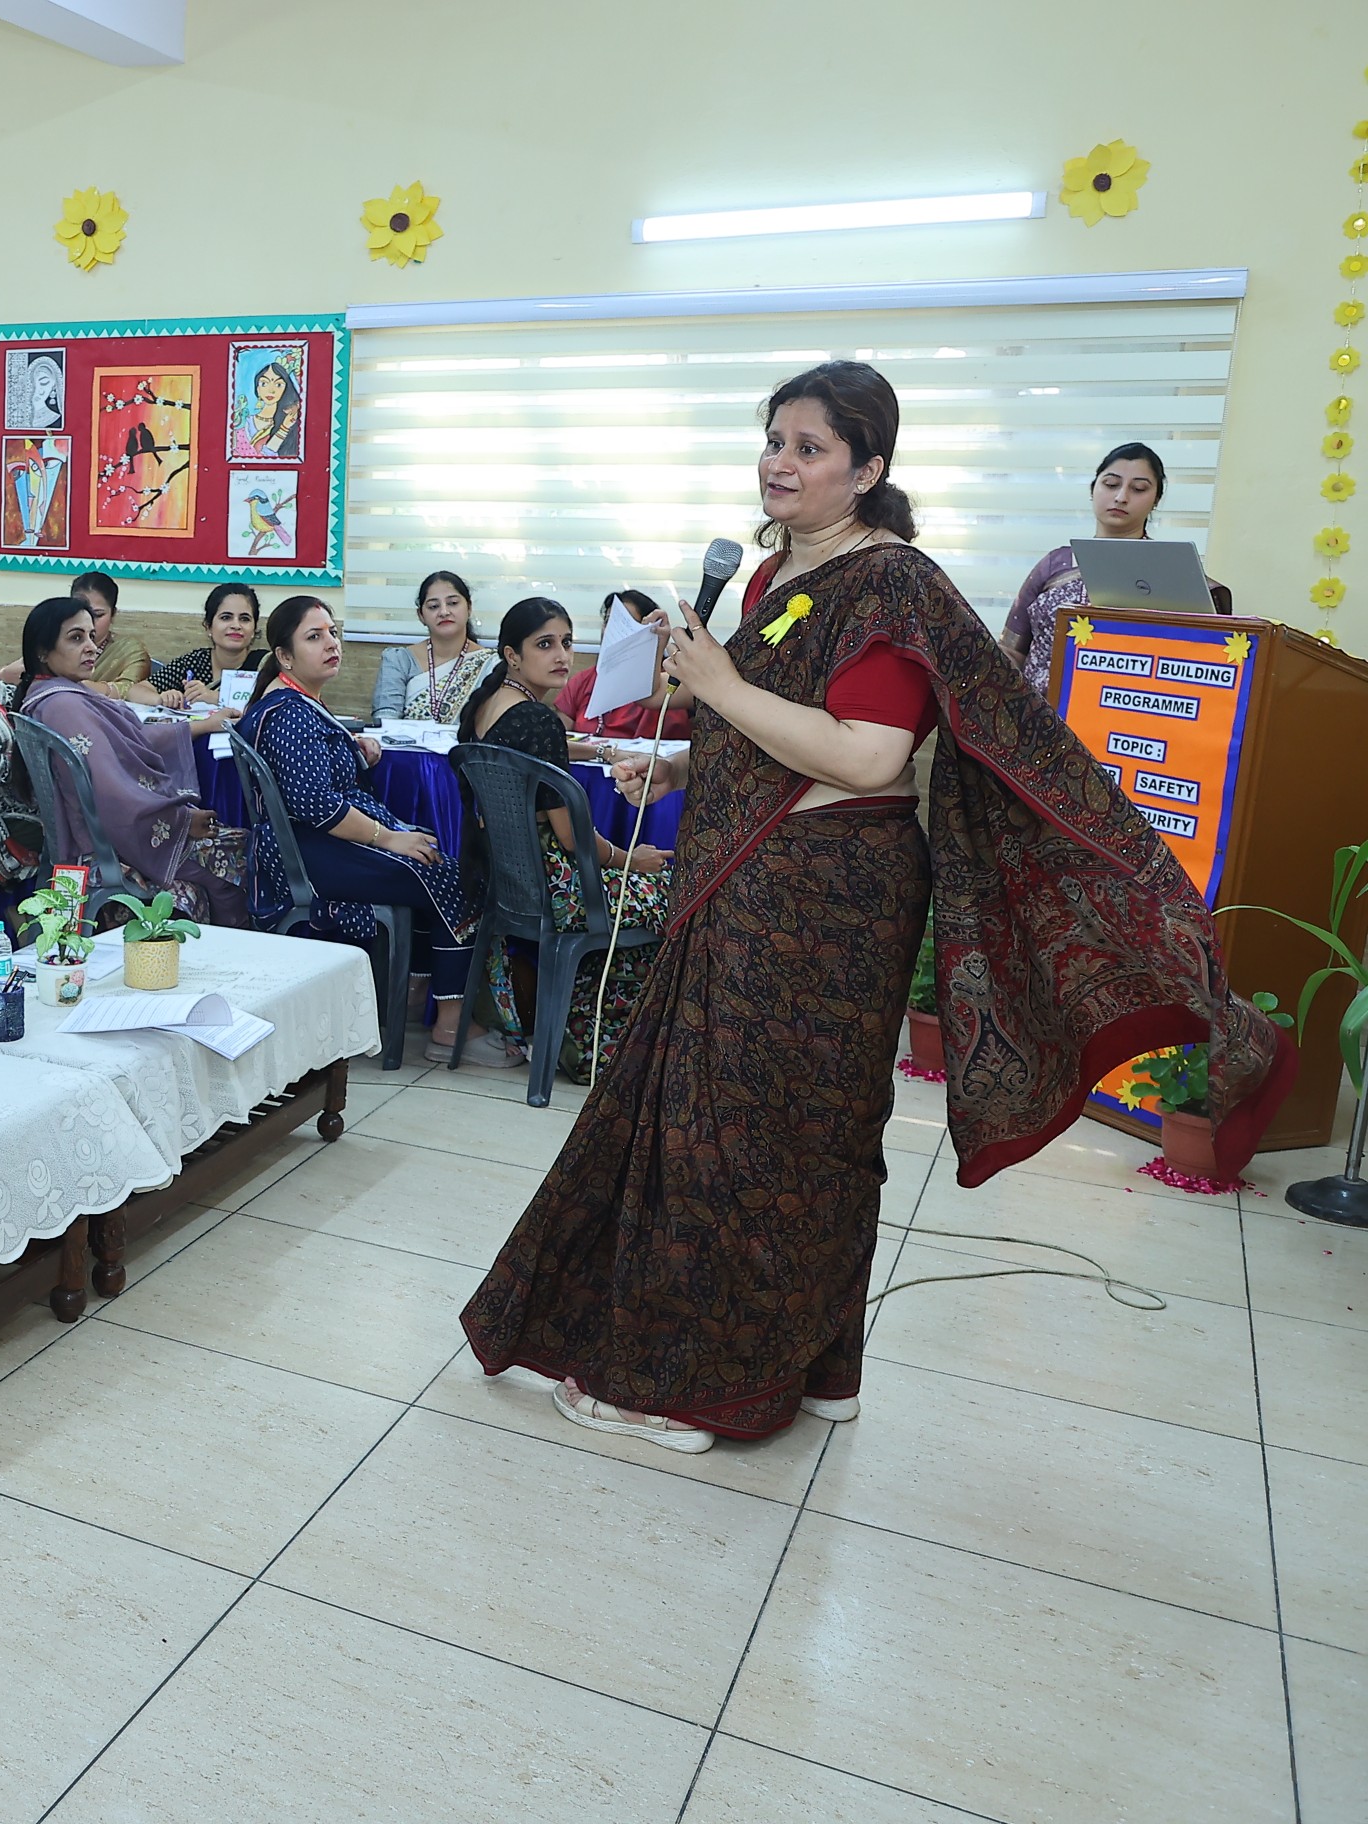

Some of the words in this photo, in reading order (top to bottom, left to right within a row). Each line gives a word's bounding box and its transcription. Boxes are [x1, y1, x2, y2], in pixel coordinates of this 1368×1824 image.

[1080, 653, 1150, 673] CAPACITY
[1160, 662, 1232, 684] BUILDING
[1103, 691, 1195, 715] PROGRAMME
[1112, 738, 1154, 756] TOPIC
[1139, 776, 1195, 798] SAFETY
[1140, 810, 1192, 832] URITY
